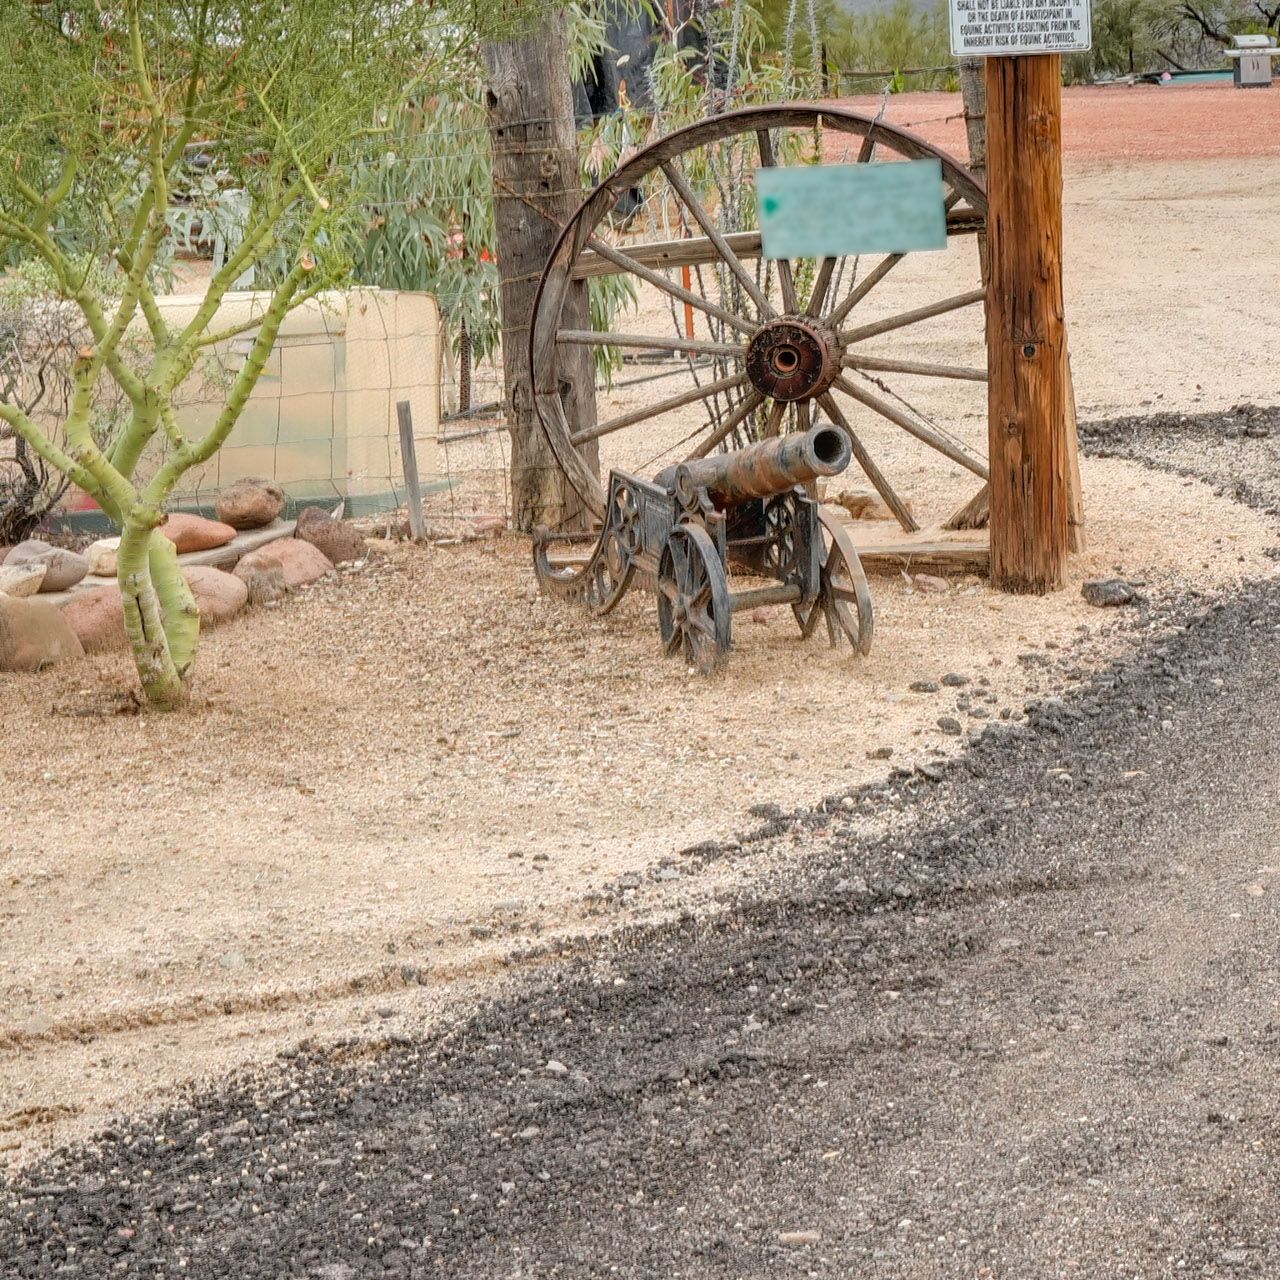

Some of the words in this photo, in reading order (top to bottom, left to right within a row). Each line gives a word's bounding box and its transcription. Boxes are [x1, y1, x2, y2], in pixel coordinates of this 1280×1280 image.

[957, 0, 975, 11] SHALL
[977, 0, 989, 10] NOT
[991, 0, 999, 9] BE
[967, 12, 976, 23] OR
[977, 11, 989, 22] THE
[990, 10, 1009, 21] DEATH
[1010, 10, 1018, 21] OF
[1020, 10, 1024, 20] A
[1025, 8, 1064, 20] PARTICIPANT
[1066, 8, 1072, 18] IN
[960, 24, 982, 36] EQUINE
[984, 22, 1015, 34] ACTIVITIES
[1017, 21, 1049, 33] RESULTING
[1051, 20, 1068, 31] FROM
[1069, 19, 1081, 30] THE
[964, 35, 993, 47] INHERENT
[995, 35, 1009, 46] RISK
[1010, 34, 1018, 45] OF
[1020, 33, 1042, 46] EQUINE
